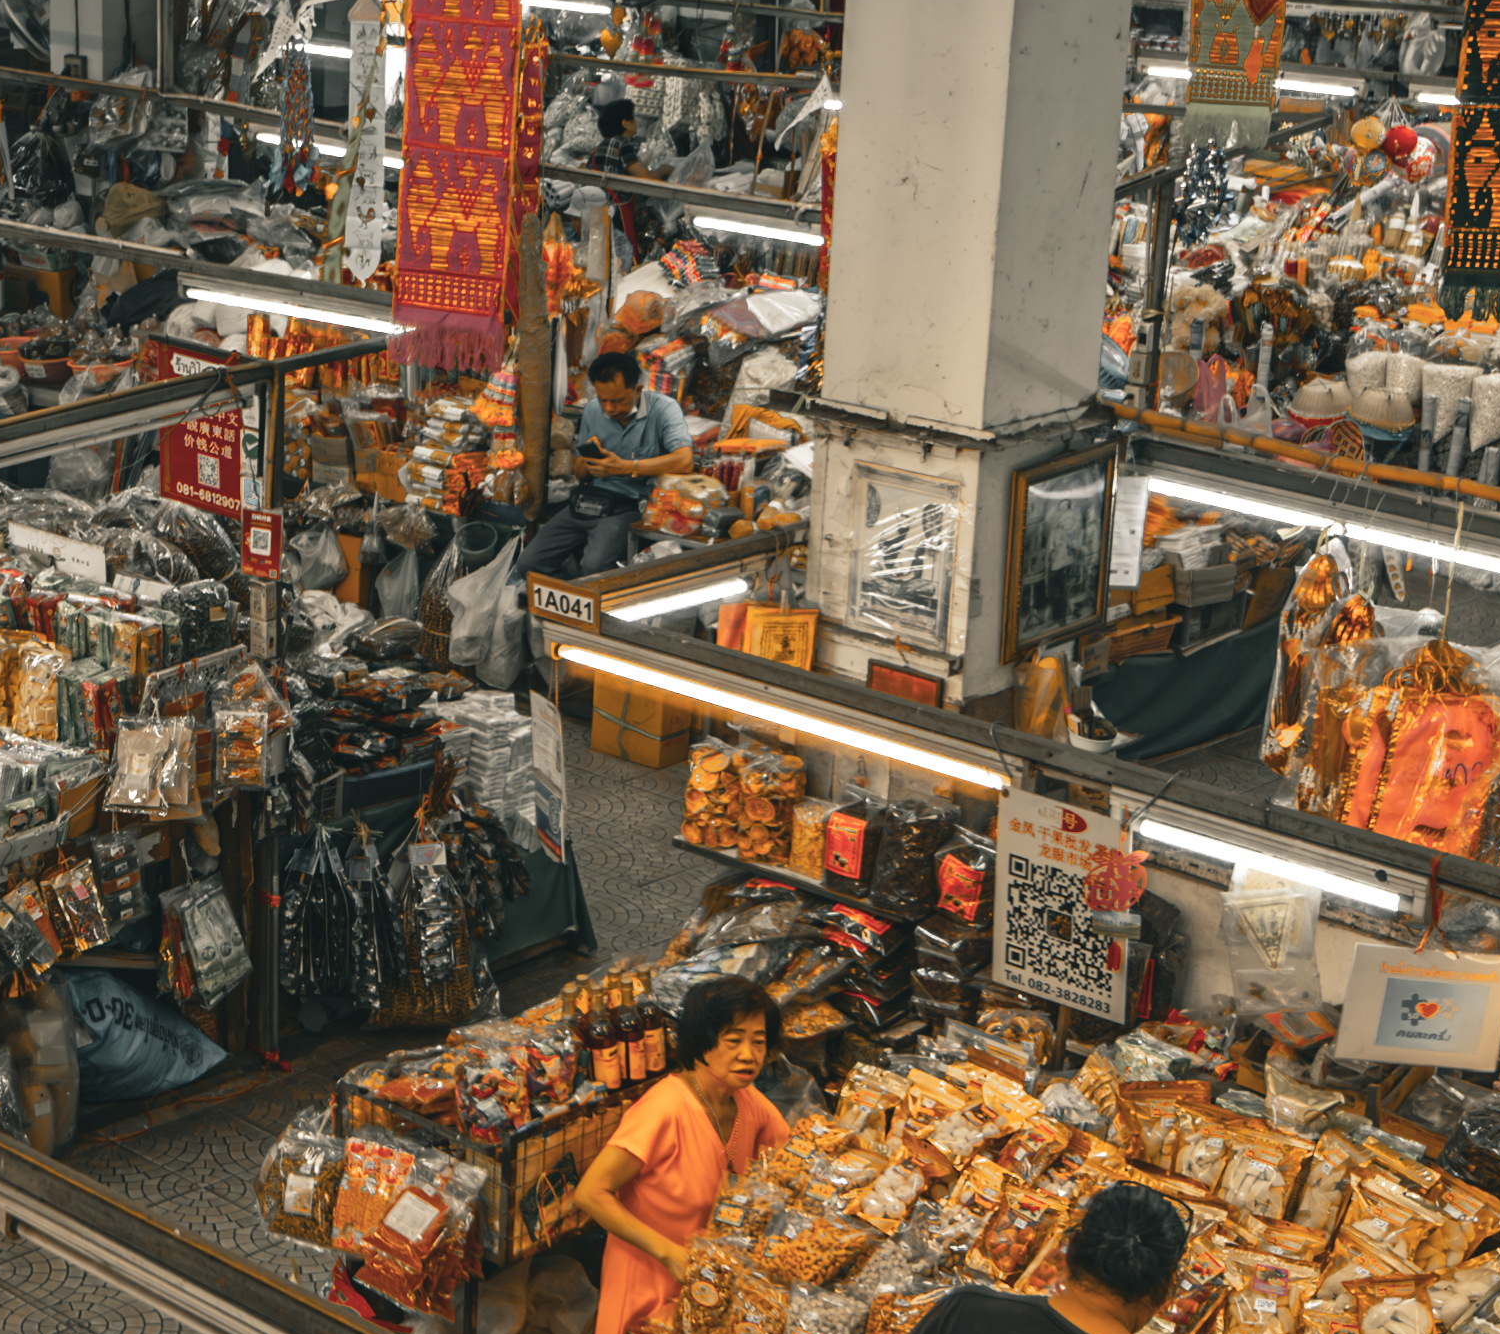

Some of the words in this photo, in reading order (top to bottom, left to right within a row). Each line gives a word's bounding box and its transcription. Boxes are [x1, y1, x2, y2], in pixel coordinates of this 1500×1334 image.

[532, 586, 594, 622] 1A041
[1004, 969, 1026, 987] Tel.
[1027, 976, 1112, 1015] 082-3828283
